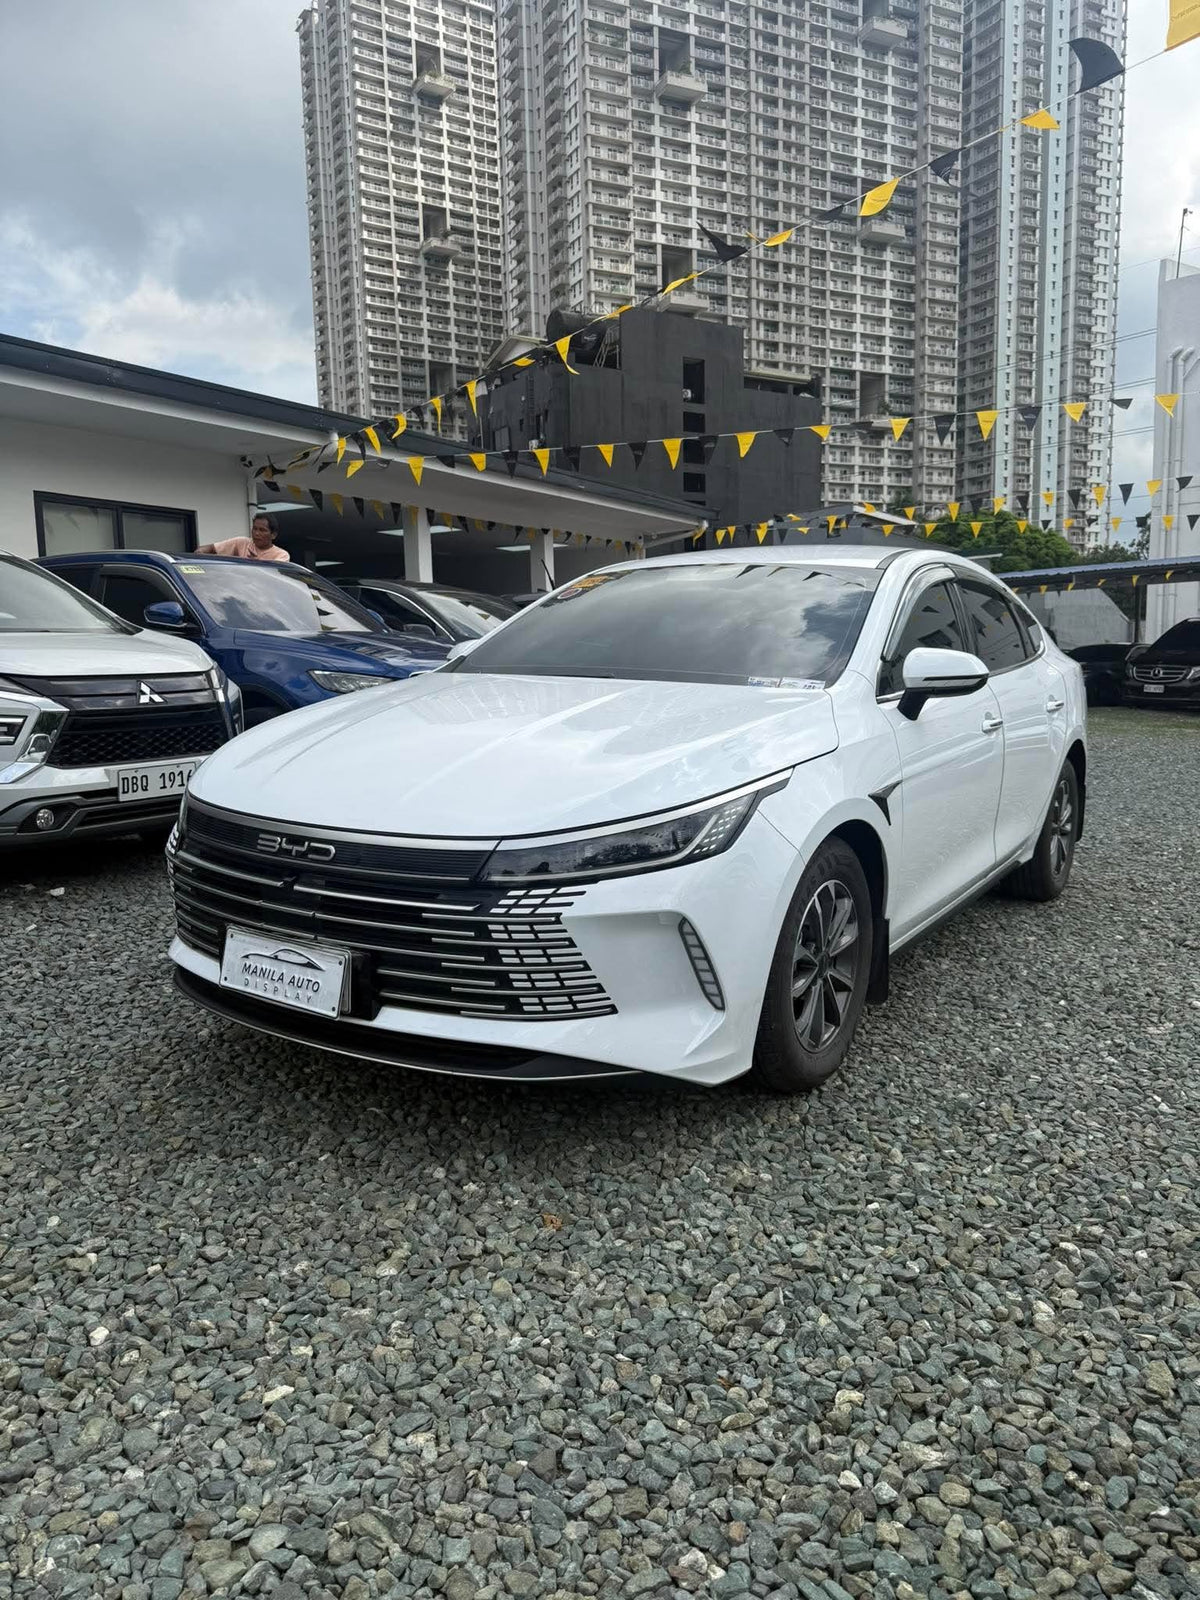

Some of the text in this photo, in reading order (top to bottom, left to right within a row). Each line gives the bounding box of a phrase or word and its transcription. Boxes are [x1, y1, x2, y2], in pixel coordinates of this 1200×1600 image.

[121, 774, 149, 794] DBQ
[257, 833, 335, 860] BYD
[241, 962, 321, 994] MANILA AUTO
[243, 978, 312, 1003] DISPLAY
